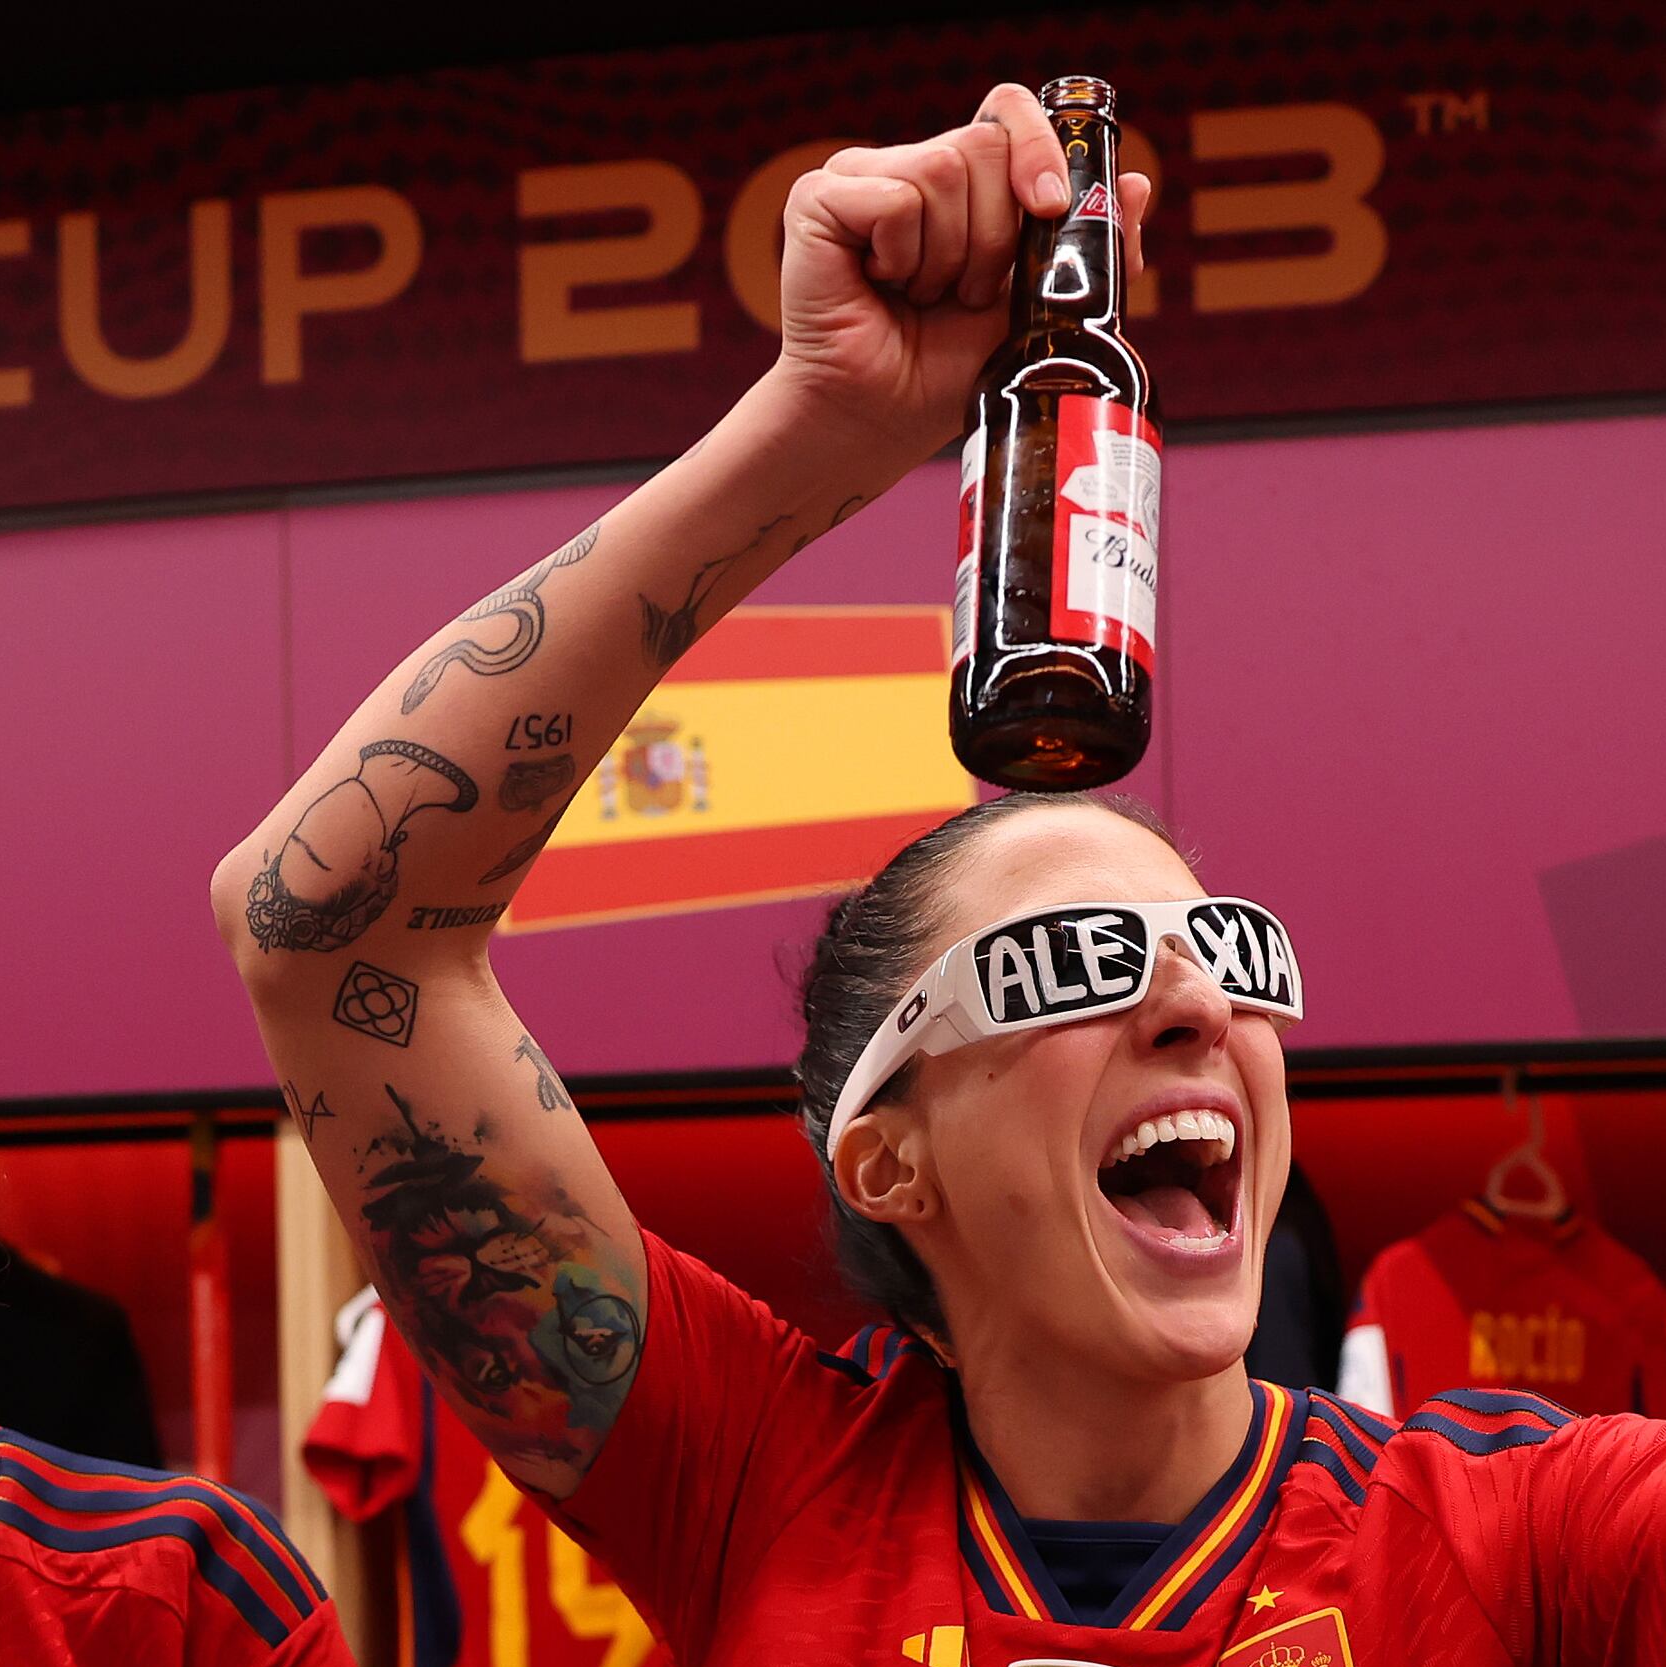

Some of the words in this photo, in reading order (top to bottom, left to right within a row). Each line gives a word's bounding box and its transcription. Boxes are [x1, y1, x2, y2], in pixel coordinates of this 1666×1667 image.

[519, 103, 1387, 362] 23
[506, 713, 572, 750] 1957
[989, 913, 1133, 1021] ALE
[1193, 906, 1293, 997] XIA
